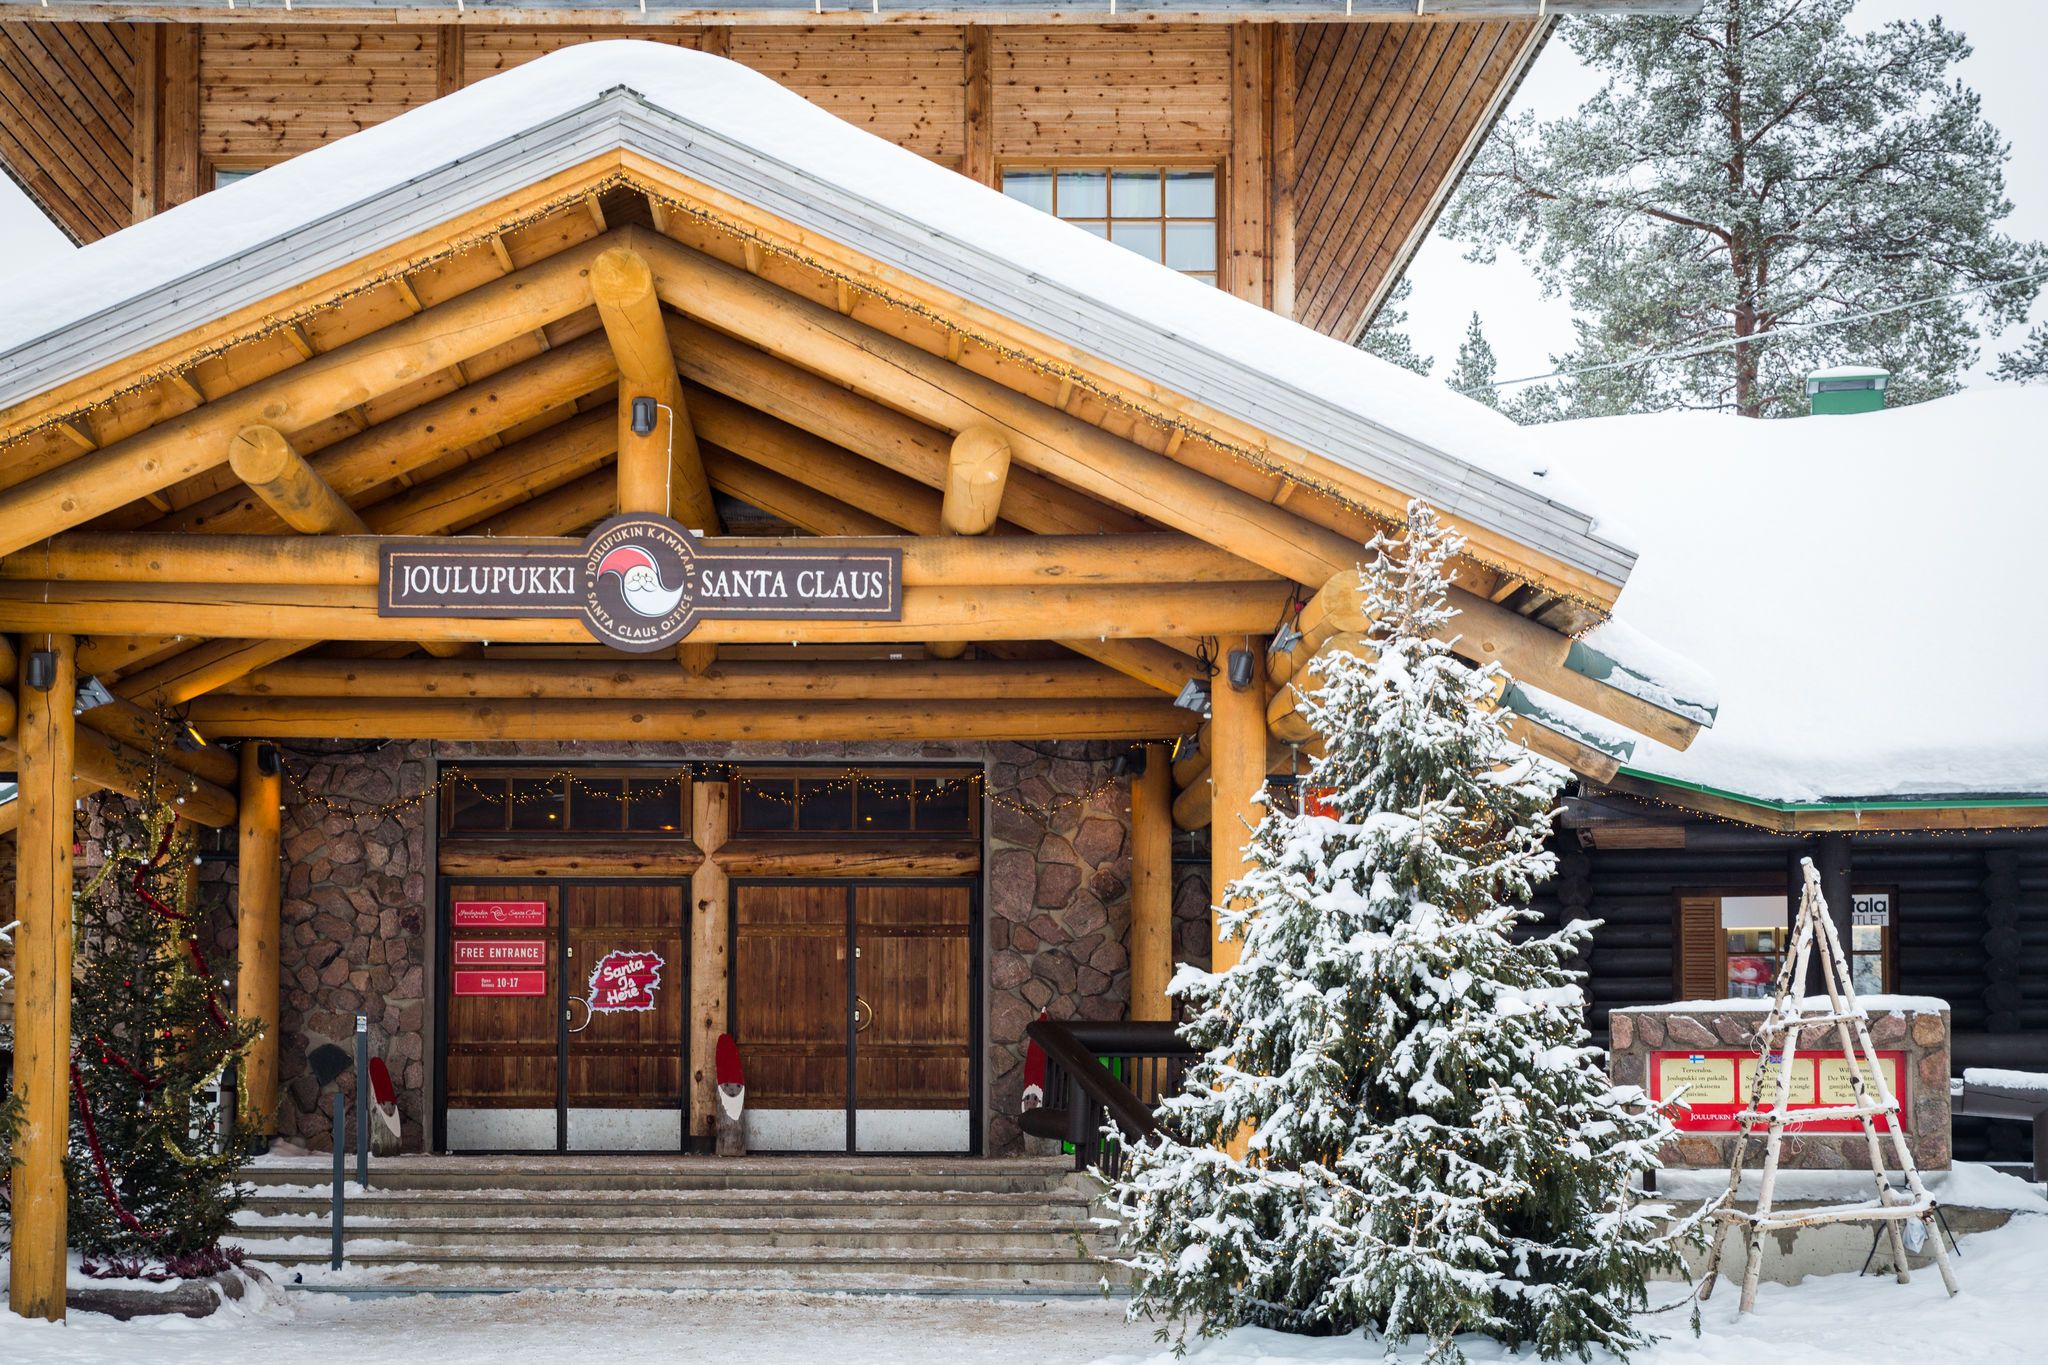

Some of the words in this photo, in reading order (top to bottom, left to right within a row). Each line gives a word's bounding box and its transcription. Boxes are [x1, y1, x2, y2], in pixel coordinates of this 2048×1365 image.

[585, 527, 643, 576] JOULUPUKIN
[648, 528, 695, 576] KAMMARI
[402, 565, 576, 597] JOULUPUKKI
[700, 570, 788, 598] SANTA
[796, 571, 883, 599] CLAUS
[587, 592, 614, 629] SANTA
[618, 625, 658, 638] CLAUS
[661, 594, 693, 631] OFFICE
[1852, 897, 1887, 913] tala
[460, 947, 485, 958] FREE
[489, 947, 539, 958] ENTRANCE
[603, 960, 645, 982] Santa
[497, 977, 519, 988] 10-17
[618, 976, 636, 991] Is
[607, 987, 640, 1005] Here
[1690, 1113, 1731, 1121] JOULUPUKIN
